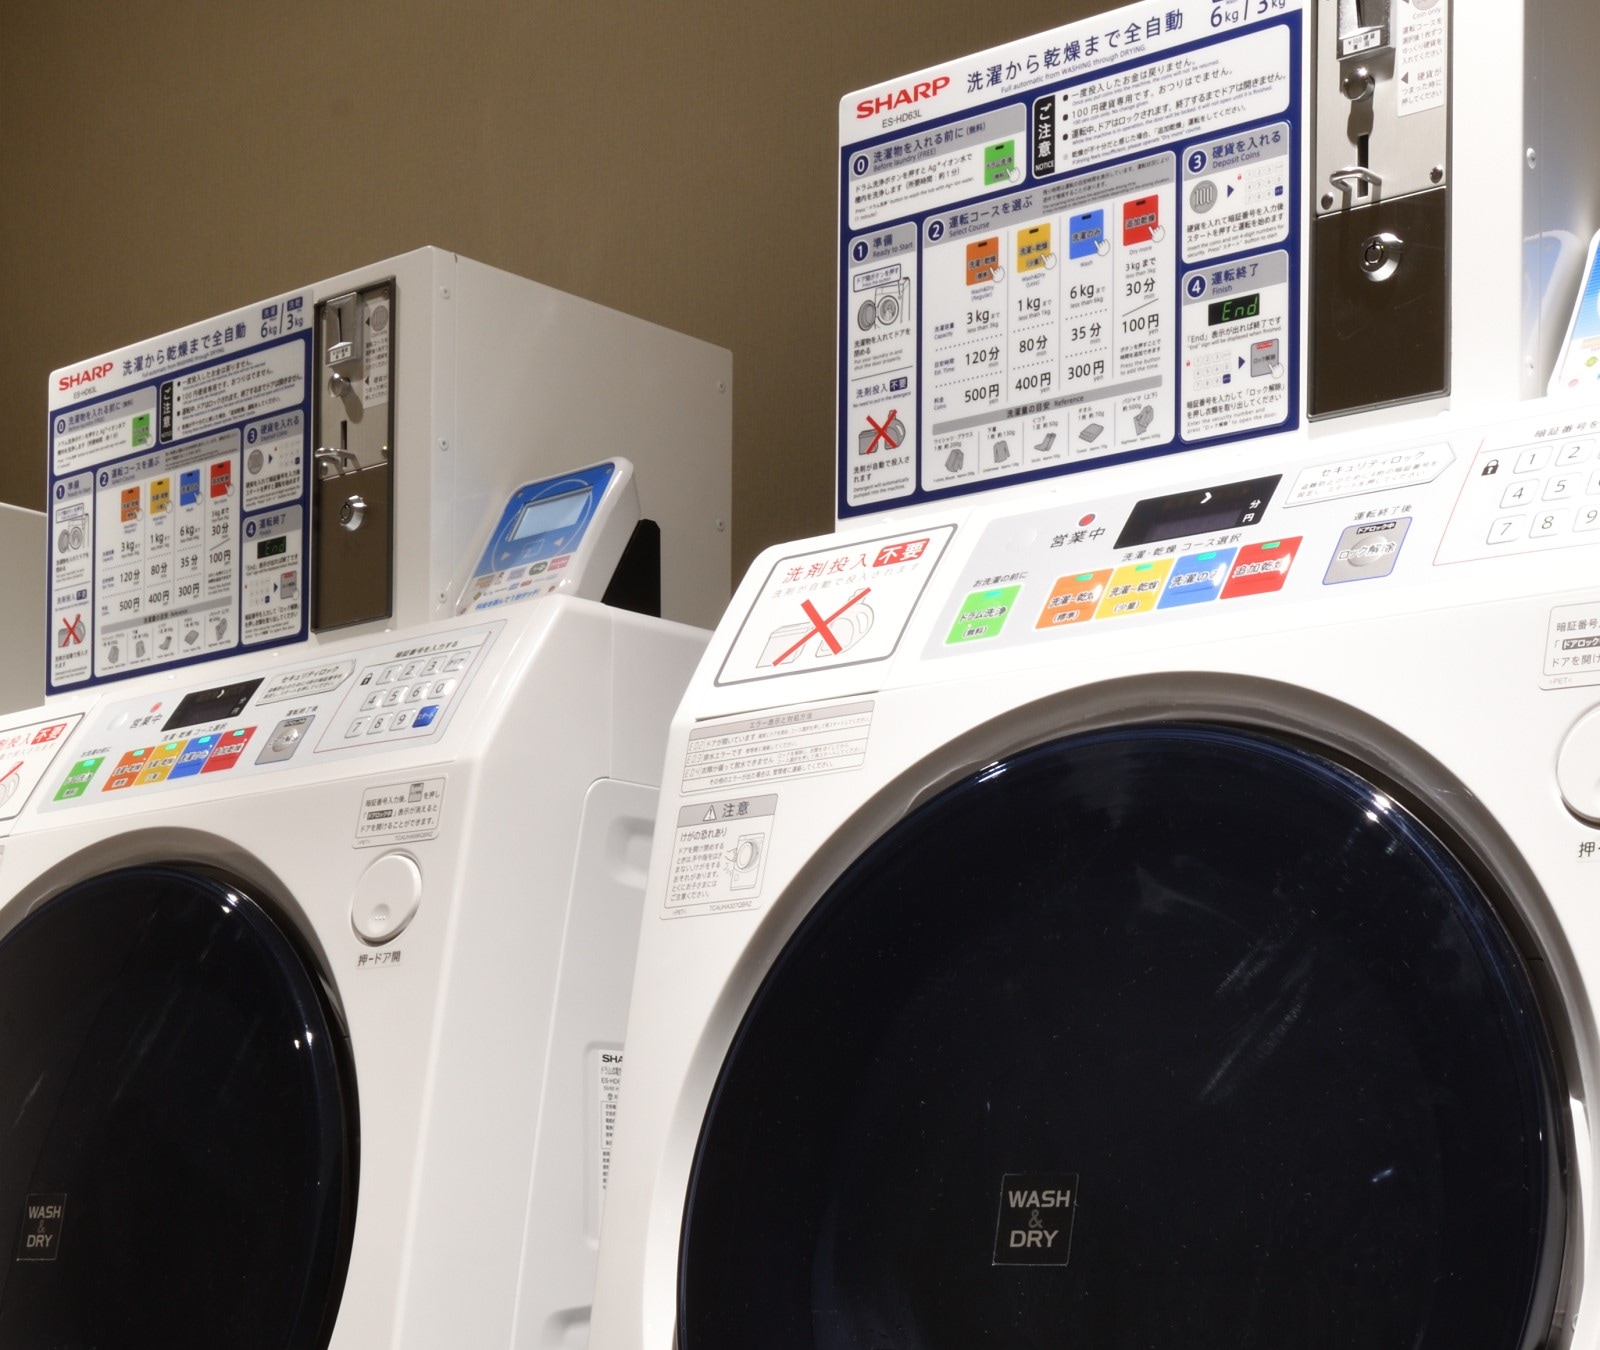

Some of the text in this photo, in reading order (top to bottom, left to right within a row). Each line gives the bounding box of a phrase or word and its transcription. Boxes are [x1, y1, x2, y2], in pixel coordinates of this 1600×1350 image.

[1402, 18, 1442, 34] 運転コースを
[967, 9, 1183, 94] 洗濯から乾燥まで全自動
[1072, 59, 1196, 99] 一度投入したお金は戻りません。
[1418, 68, 1442, 81] 硬貨が
[1402, 79, 1442, 95] つまった時に
[856, 76, 950, 119] SHARP
[882, 110, 922, 128] ES-HD63L
[1038, 103, 1052, 158] ご注意
[873, 125, 964, 164] 洗濯物を入れる前に
[1212, 131, 1281, 159] 硬貨を入れる
[1035, 161, 1055, 171] NOTICE
[1213, 151, 1260, 168] Deposit Coins
[949, 197, 1032, 229] 運転コースを選ぶ
[1187, 203, 1284, 233] 硬貨を入れて暗証番号を入力後
[1187, 213, 1283, 243] スタートを押すと運転を始めます
[873, 234, 892, 247] 準備
[1212, 263, 1258, 286] 運転終了
[1212, 285, 1232, 296] Finish
[1222, 297, 1258, 321] End
[1123, 314, 1159, 334] 100円
[854, 328, 911, 349] 洗濯物を入れてドアを
[1019, 335, 1047, 353] 80分
[122, 322, 246, 377] 洗濯から乾燥まで全自動
[965, 347, 1000, 366] 120分
[58, 361, 114, 391] SHARP
[1068, 360, 1104, 380] 300円
[856, 378, 907, 399] 洗剤投入 不要
[1015, 372, 1051, 392] 400円
[965, 384, 1000, 403] 500円
[162, 386, 171, 429] ご注意
[1007, 395, 1084, 418] 洗濯量の目安 Reference
[1187, 394, 1281, 420] を押し衣類を取り出してください
[260, 416, 300, 435] 硬貨を入れる
[1568, 446, 1581, 458] 2
[853, 456, 910, 474] 洗剤が自動で投入さ
[1321, 451, 1425, 477] セキュリティロック
[1513, 487, 1524, 499] 4
[1555, 479, 1567, 492] 5
[1250, 499, 1261, 509] 分
[1353, 504, 1412, 521] 運転終了後
[1242, 512, 1255, 523] 円
[1542, 515, 1554, 529] 8
[1587, 509, 1598, 523] 9
[1050, 526, 1107, 549] 営業中
[1502, 522, 1512, 535] 7
[782, 542, 926, 585] 洗剤投入 不要
[972, 570, 1029, 588] お洗濯の前に
[958, 605, 1007, 623] ドラム洗浄
[722, 801, 750, 818] 注意
[680, 828, 727, 842] けがの恐れあり
[1008, 1190, 1071, 1208] WASH
[29, 1206, 61, 1219] WASH
[1028, 1209, 1043, 1228] &
[27, 1235, 53, 1247] DRY
[1009, 1230, 1059, 1247] DRY
